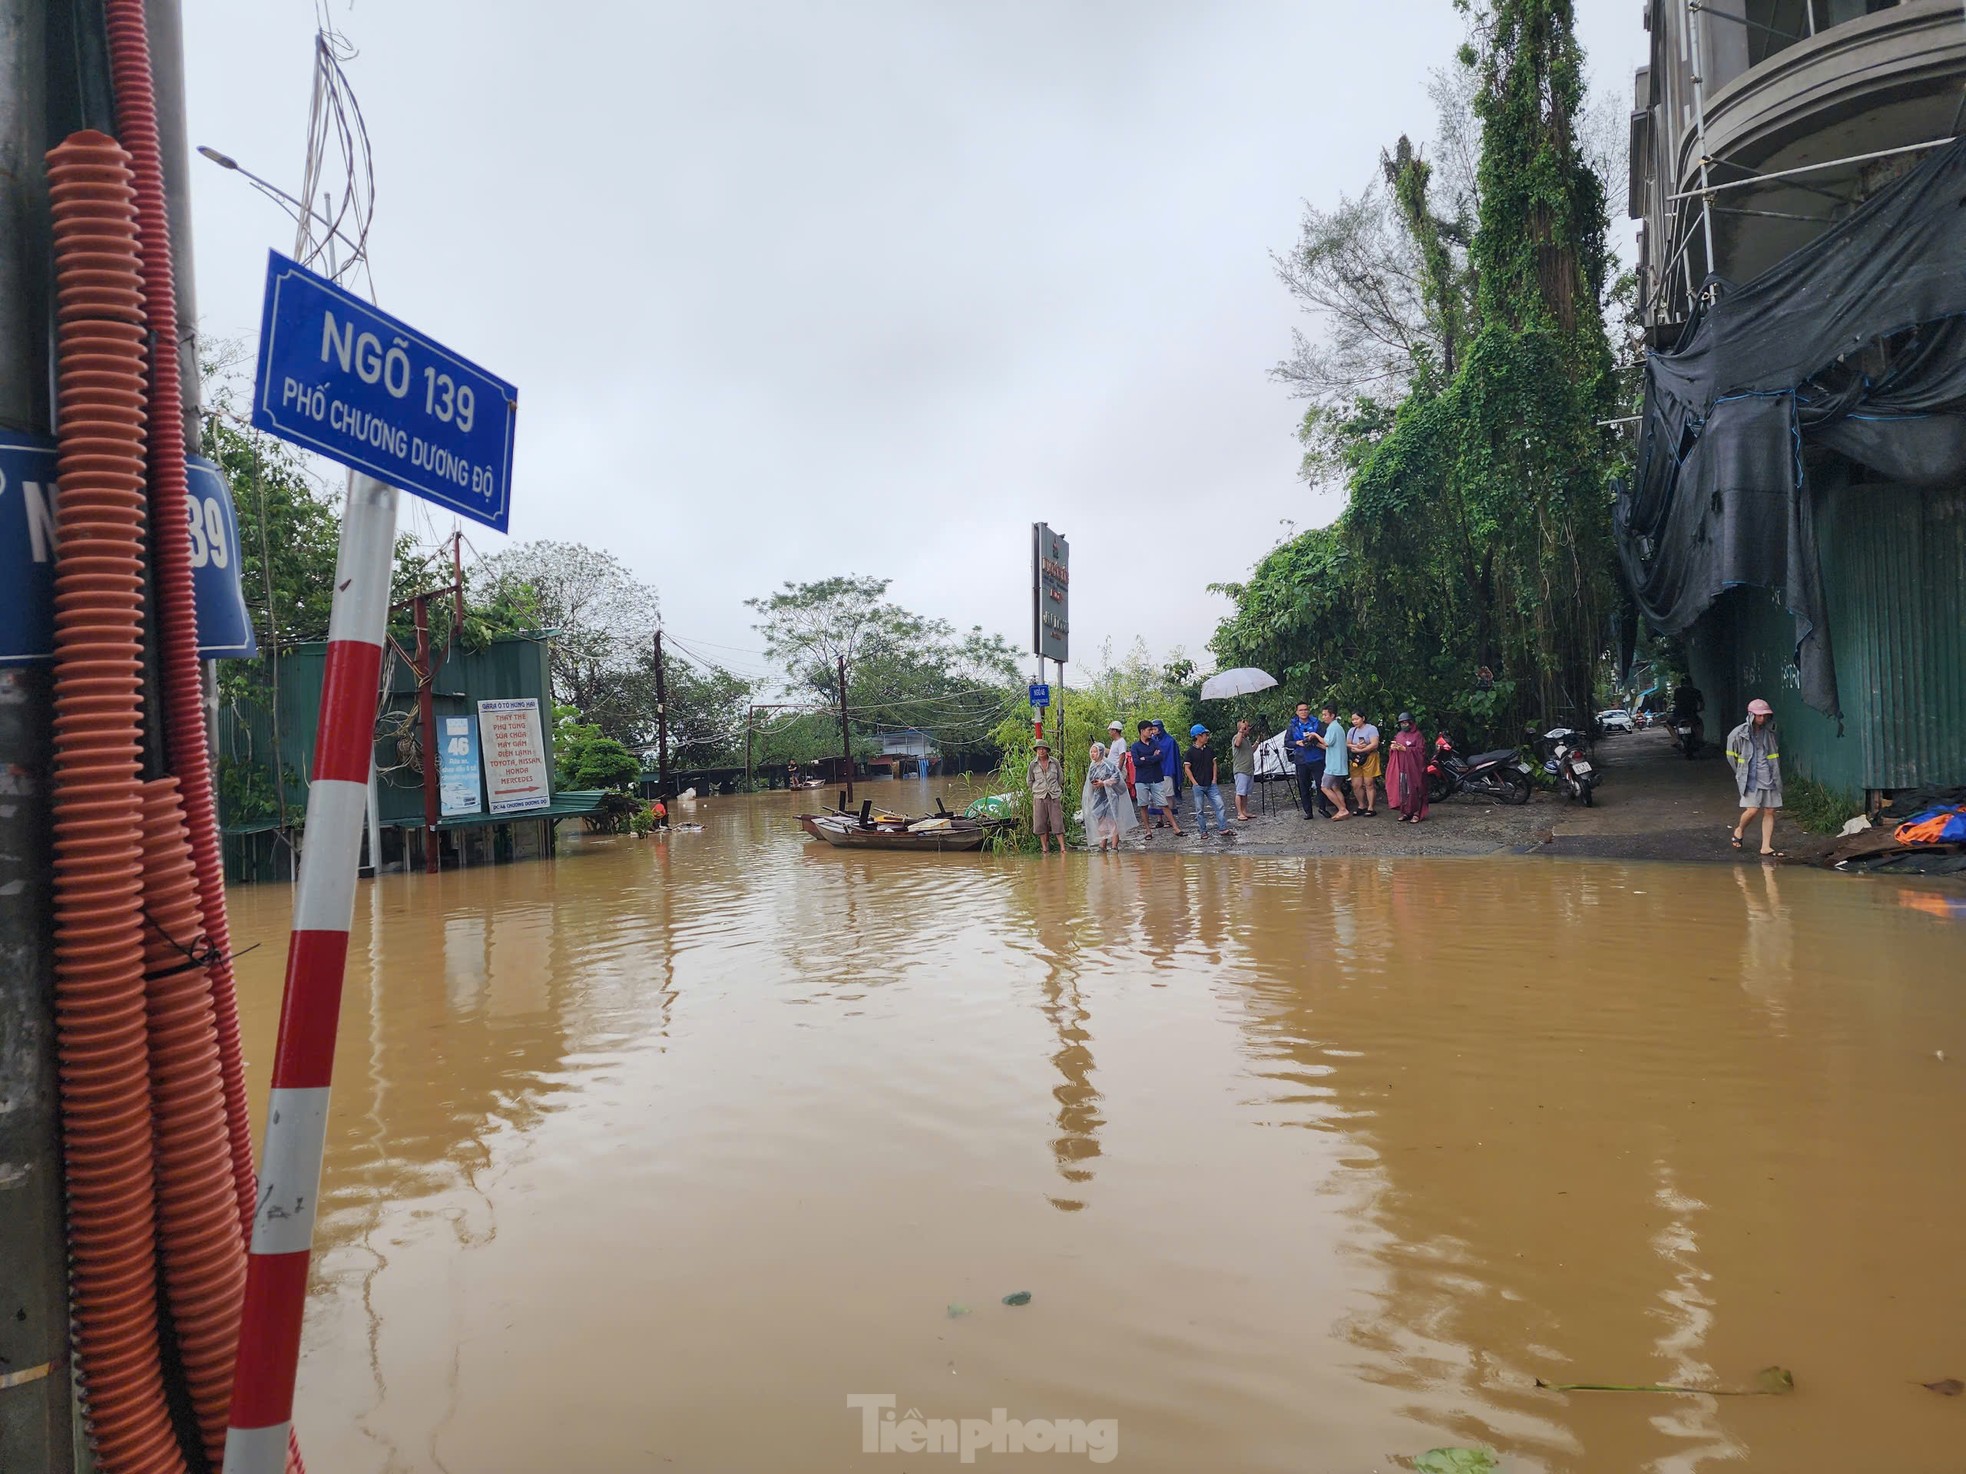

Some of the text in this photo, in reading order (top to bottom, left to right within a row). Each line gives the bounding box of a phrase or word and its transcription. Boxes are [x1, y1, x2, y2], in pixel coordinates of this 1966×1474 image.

[321, 310, 475, 433] NGÕ 139
[282, 377, 495, 503] PHỐ CHƯƠNG DƯƠNG ĐỘ
[187, 495, 228, 569] 39
[448, 737, 470, 756] 46
[500, 776, 534, 784] MERCEDES
[506, 768, 529, 776] HONDA
